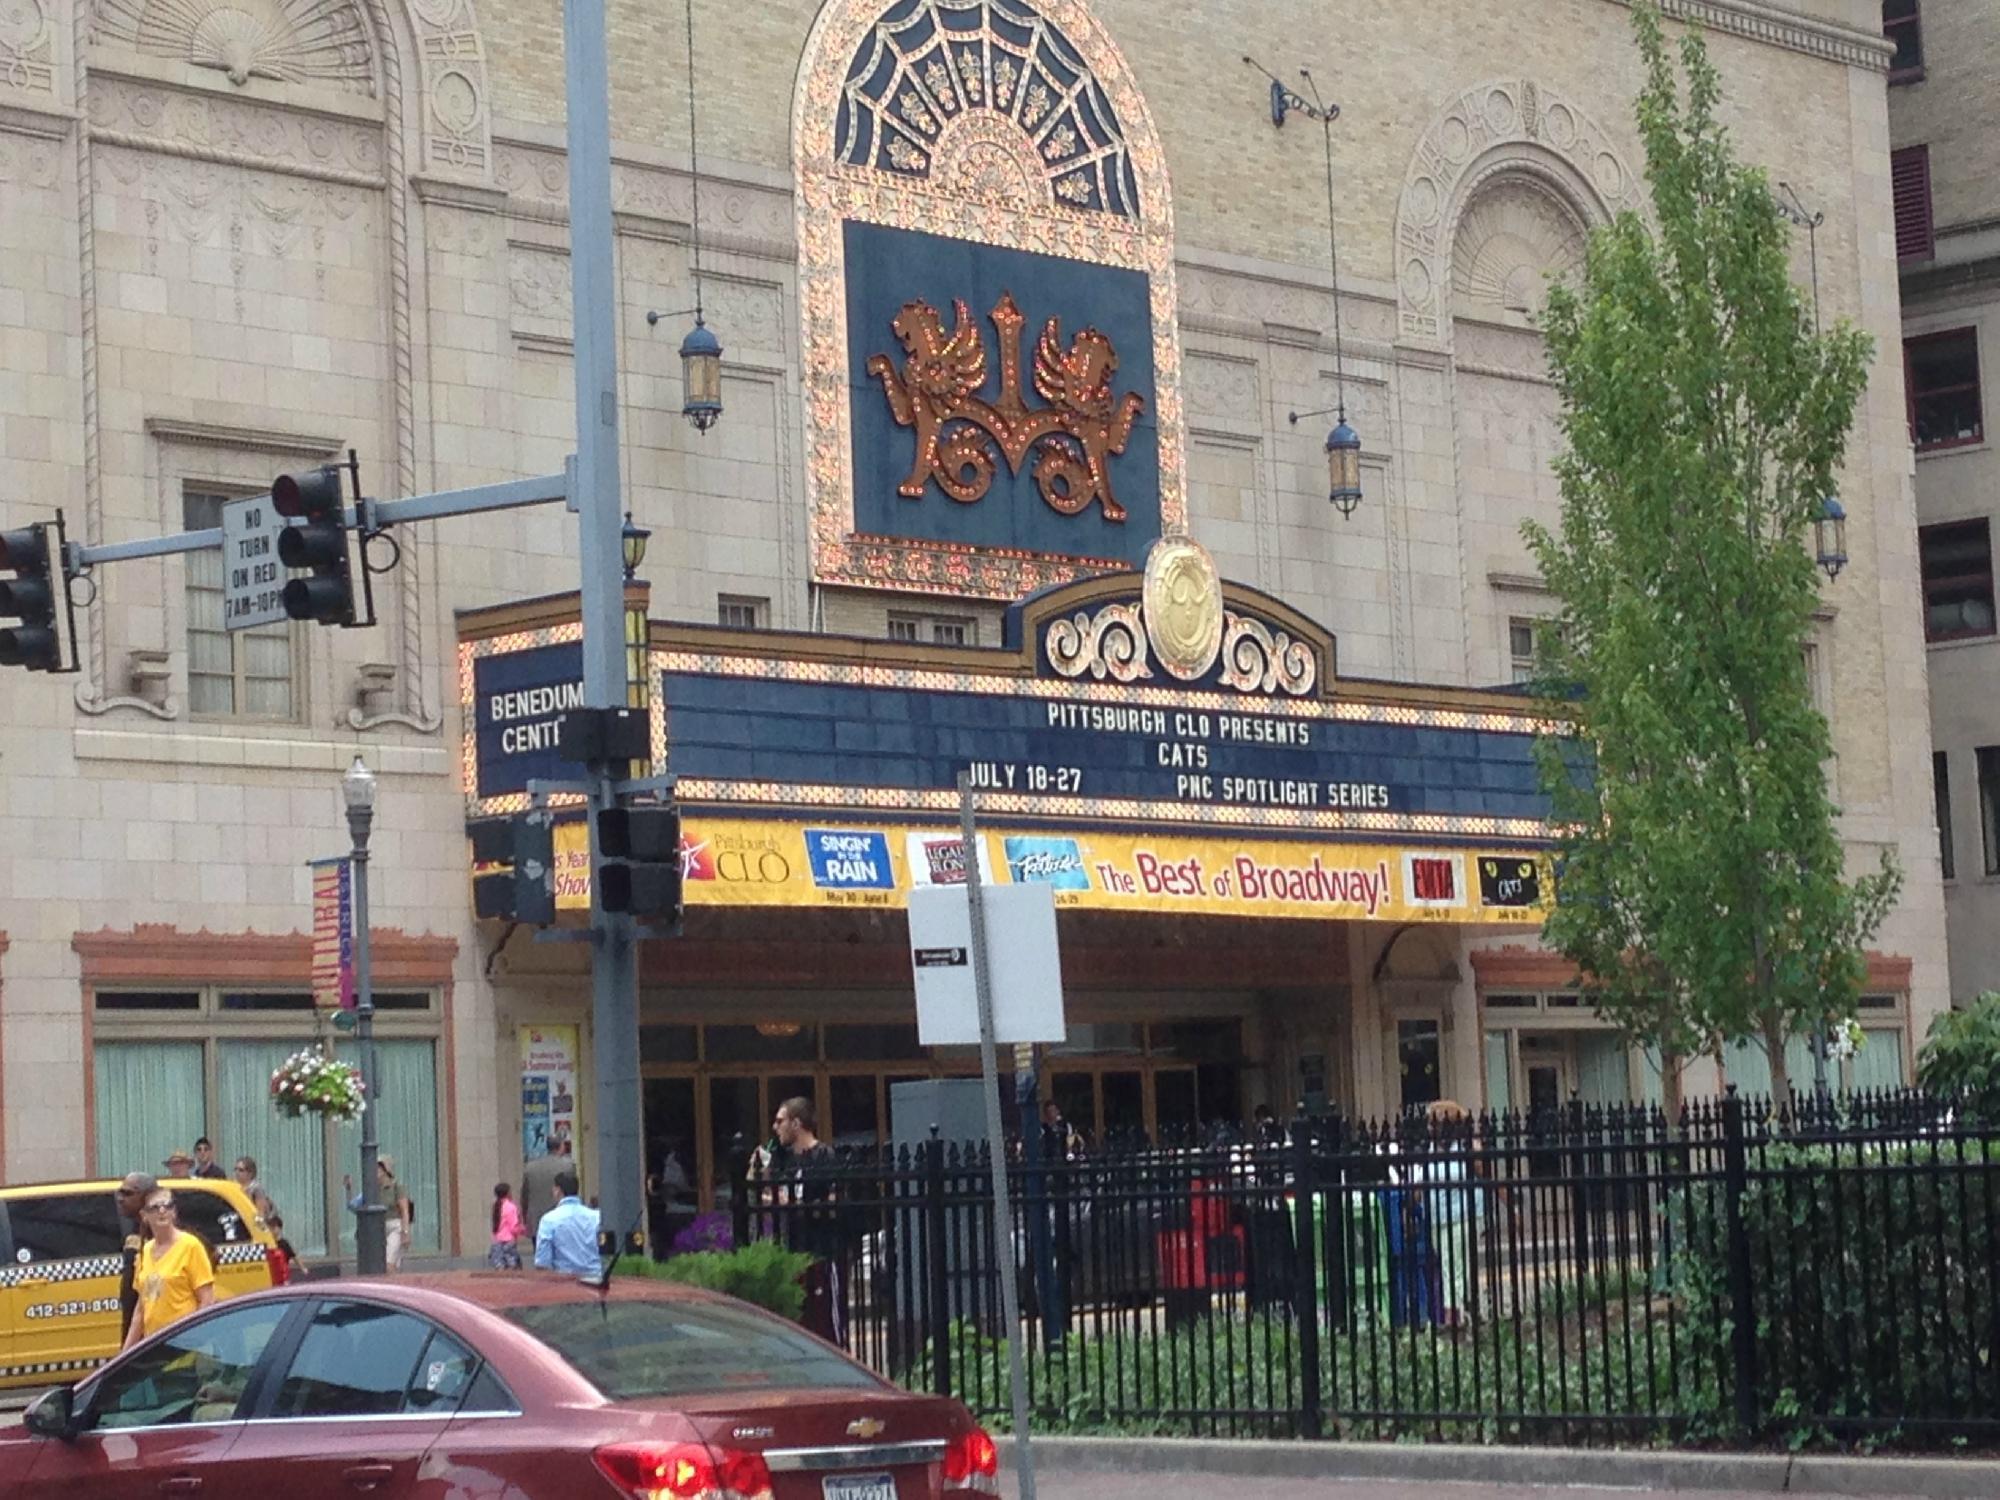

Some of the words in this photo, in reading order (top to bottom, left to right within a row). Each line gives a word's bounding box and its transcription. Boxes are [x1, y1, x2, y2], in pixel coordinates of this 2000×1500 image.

[245, 508, 261, 530] NO
[239, 535, 269, 559] TURN
[233, 568, 248, 589] ON
[254, 562, 276, 585] RED
[491, 681, 585, 721] BENEDUM
[1047, 702, 1166, 735] PITTSBURGH
[1174, 713, 1210, 738] CLO
[1219, 716, 1309, 745] PRESENTS
[1158, 742, 1207, 768] CATS
[969, 762, 1016, 789] JULY
[1027, 765, 1081, 793] 18-27
[1177, 774, 1213, 799] PNC
[1222, 777, 1319, 805] SPOTLIGHT
[1327, 783, 1389, 808] SERIES
[715, 832, 782, 853] Pittsburgh
[717, 851, 790, 884] CLO
[825, 860, 878, 882] RAIN
[1096, 864, 1136, 893] The
[1136, 853, 1206, 896] Best
[1213, 869, 1232, 896] of
[1235, 857, 1389, 914] Broadway!
[1498, 878, 1522, 900] CATS
[26, 1298, 119, 1318] 412-321-810
